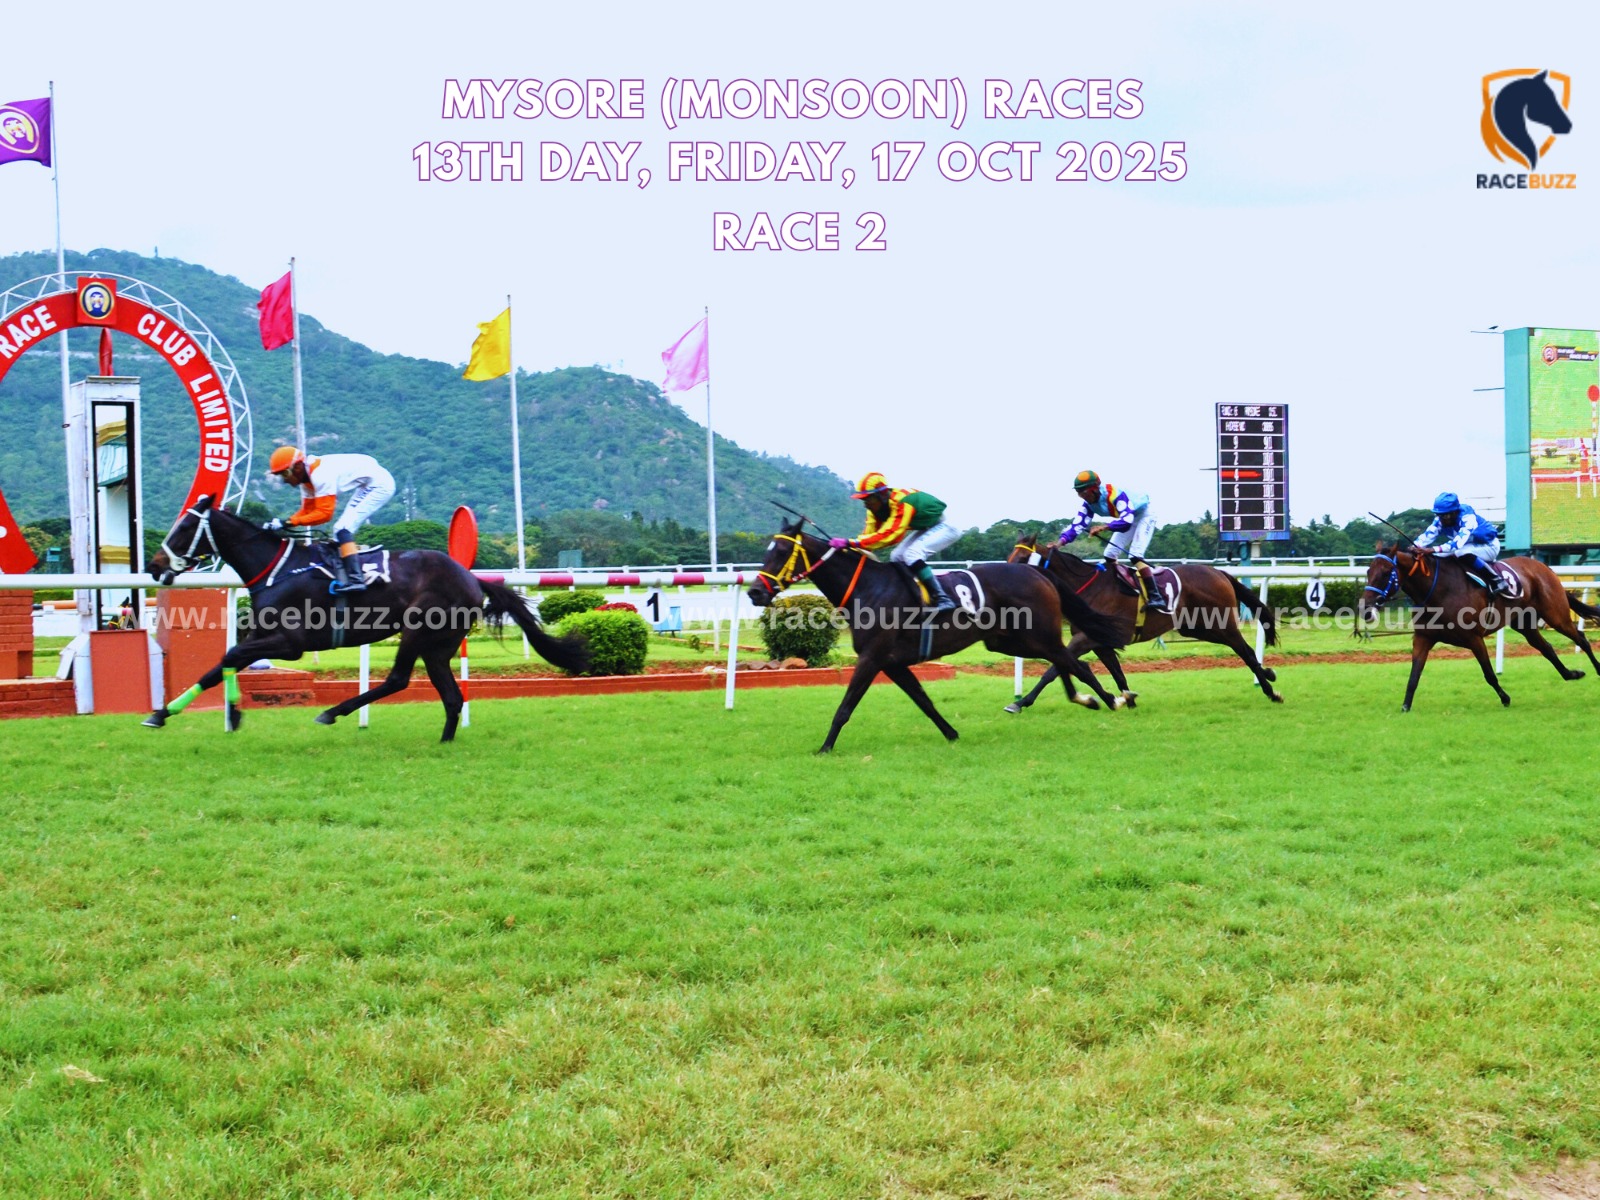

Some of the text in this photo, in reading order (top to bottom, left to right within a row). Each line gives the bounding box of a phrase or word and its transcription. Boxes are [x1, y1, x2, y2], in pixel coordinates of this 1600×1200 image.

[0, 305, 230, 473] RACE CLUB LIMITED
[1165, 582, 1174, 611] 1
[1310, 582, 1320, 606] 4
[1502, 570, 1518, 596] 3
[647, 592, 659, 622] 1
